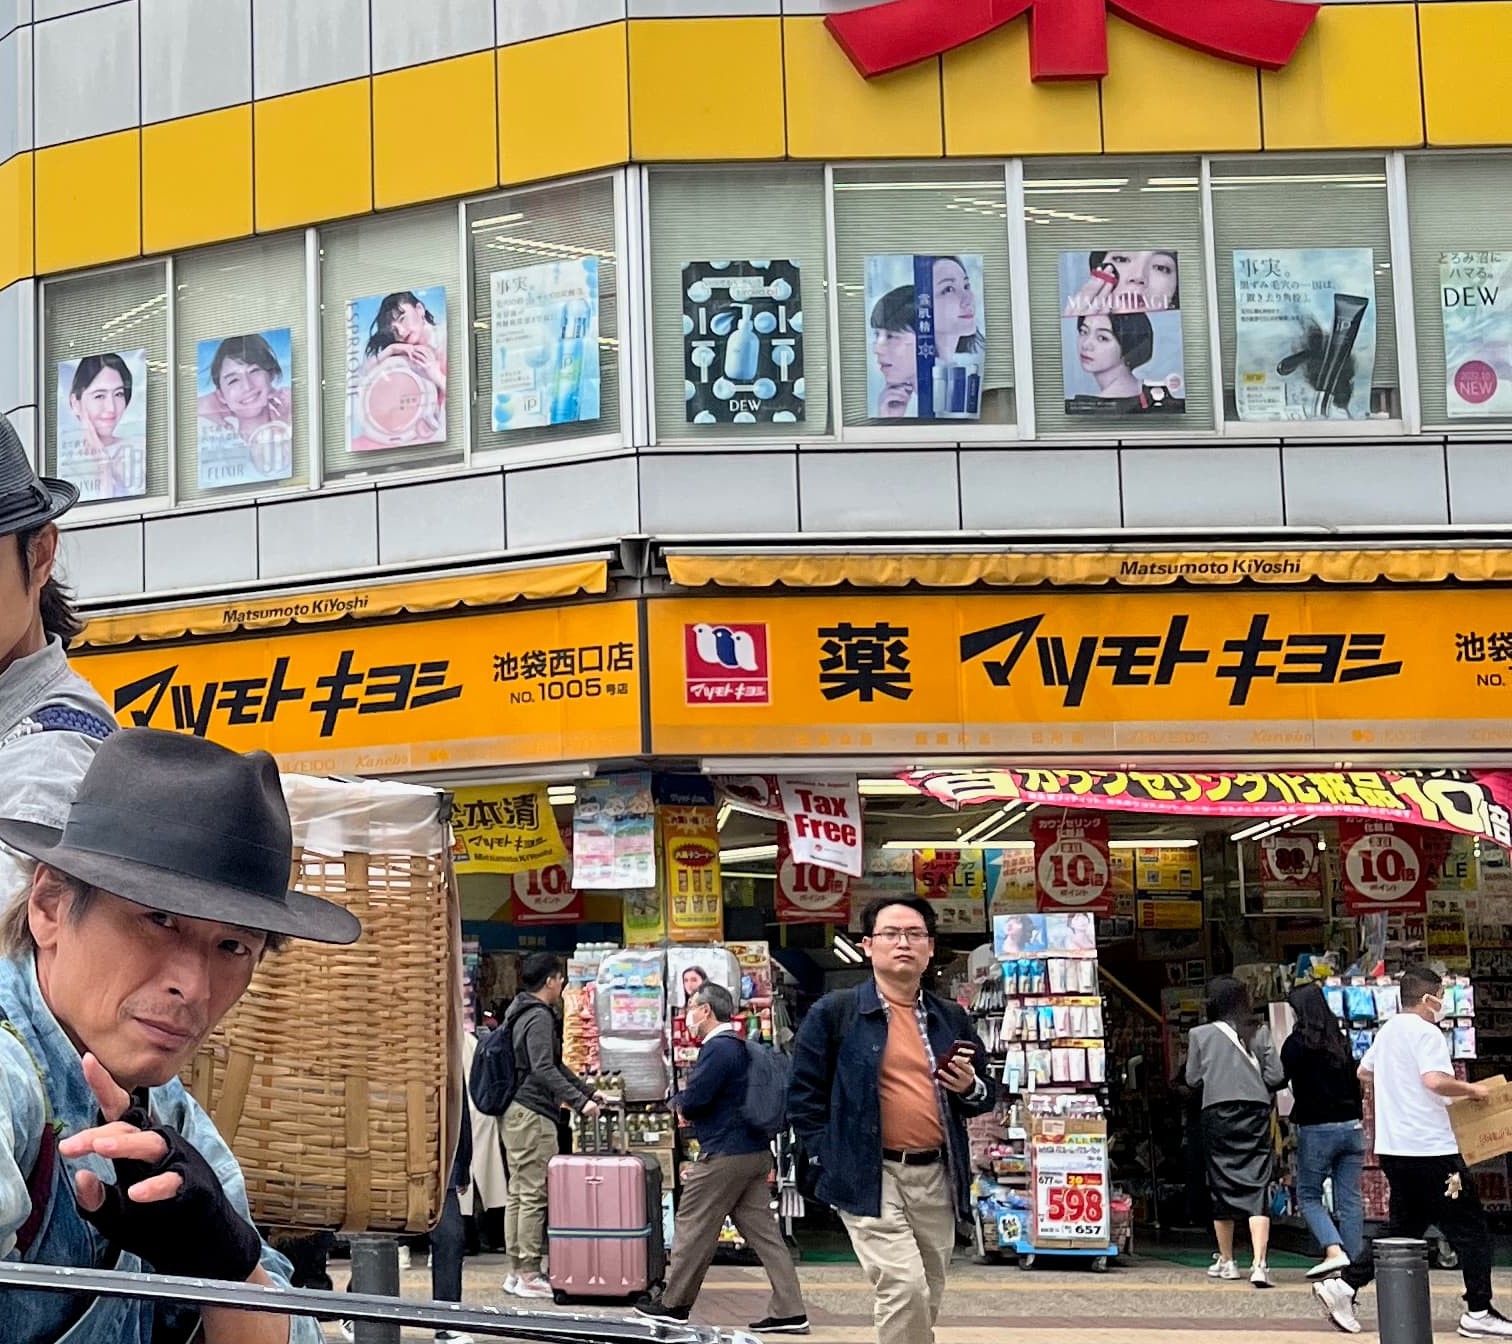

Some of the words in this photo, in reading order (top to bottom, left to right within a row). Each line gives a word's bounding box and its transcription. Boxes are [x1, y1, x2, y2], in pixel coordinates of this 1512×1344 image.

[1443, 286, 1499, 308] DEW
[1459, 382, 1493, 396] NEW
[729, 399, 762, 412] DEW
[207, 464, 245, 481] ELIXIR
[1120, 559, 1228, 576] Matsumoto
[1232, 556, 1301, 576] KiYoshi
[223, 603, 309, 624] Matsumoto
[311, 594, 369, 615] KiYoshi
[959, 612, 1404, 708] マツモトキヨシ
[1455, 631, 1512, 662] 池袋
[493, 642, 634, 682] 池袋西口店
[818, 622, 913, 703] 薬
[114, 649, 464, 737] マツモトキヨシ
[510, 691, 535, 704] NO.
[538, 678, 601, 701] 1005
[606, 683, 629, 696] 号店
[1476, 674, 1506, 687] NO.
[794, 789, 849, 818] Tax
[794, 814, 857, 847] Free
[922, 871, 976, 888] SALE
[1048, 1187, 1103, 1222] 598
[1075, 1225, 1102, 1235] 657
